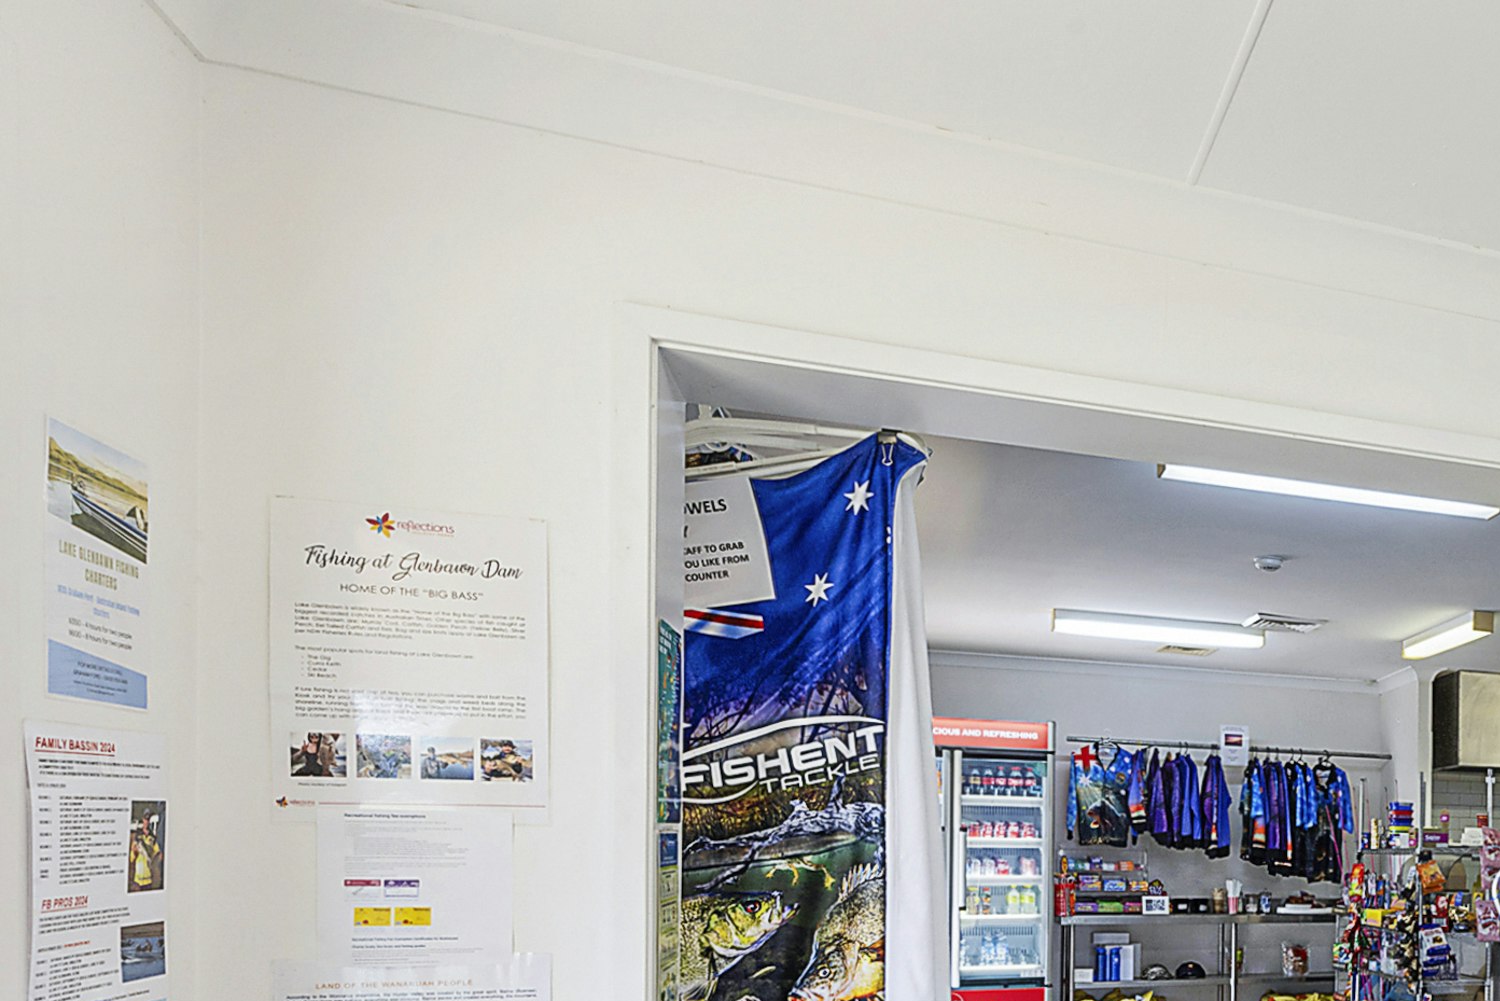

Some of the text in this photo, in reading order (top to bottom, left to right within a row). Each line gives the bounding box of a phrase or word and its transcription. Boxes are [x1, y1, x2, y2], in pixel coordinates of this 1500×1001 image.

[684, 499, 727, 514] WELS
[396, 519, 455, 535] reflections
[704, 542, 744, 553] TO GRAB
[305, 545, 522, 581] Fishing at Glenbawn Dam
[702, 555, 749, 567] LIKE FROM
[685, 570, 729, 582] COUNTER
[340, 584, 376, 594] HOME
[380, 585, 396, 595] OF
[400, 587, 419, 596] THE
[962, 729, 981, 737] AND
[982, 730, 1039, 740] REFRESHING
[36, 737, 115, 752] FAMILY BASSIN 2024
[683, 723, 884, 792] FISHENT
[758, 754, 880, 794] TACKLE
